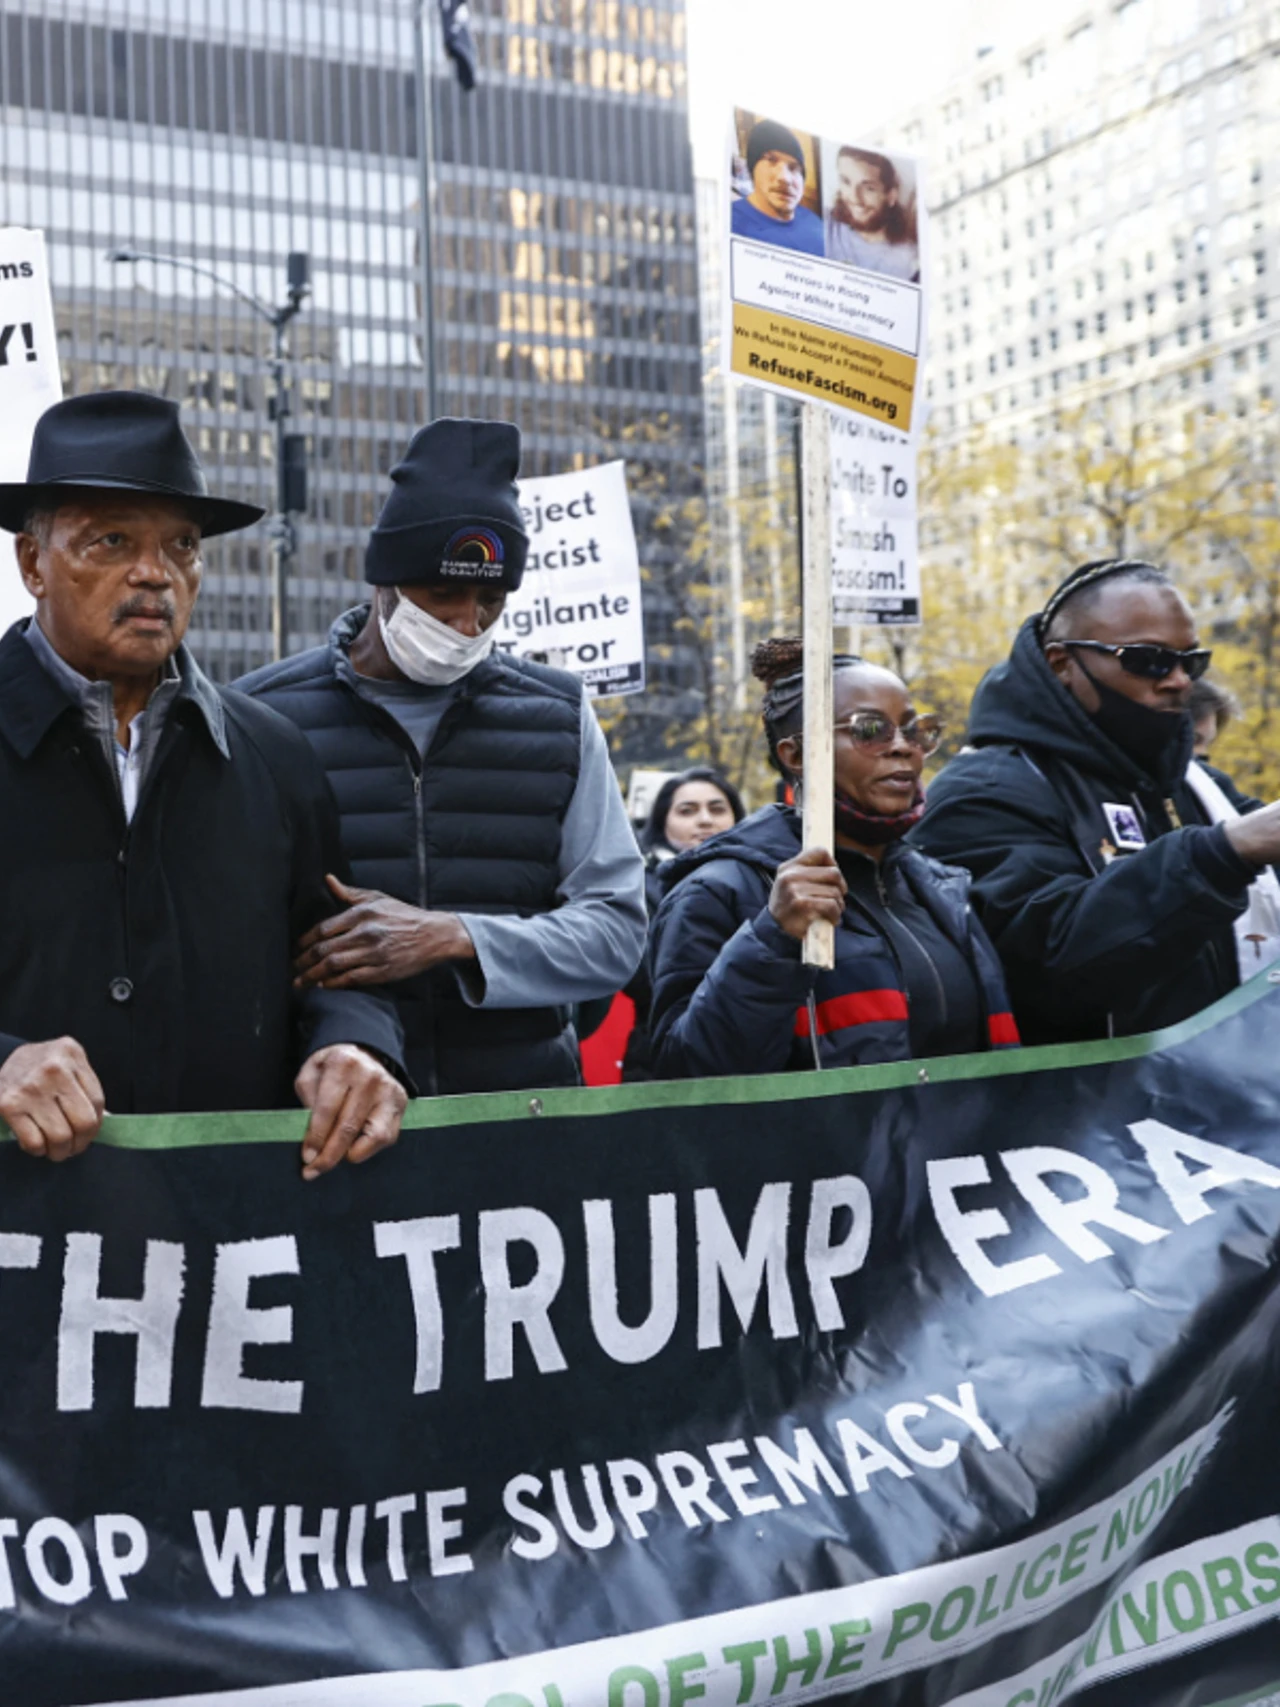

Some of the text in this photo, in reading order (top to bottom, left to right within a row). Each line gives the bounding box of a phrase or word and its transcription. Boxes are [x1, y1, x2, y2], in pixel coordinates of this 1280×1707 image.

[734, 325, 749, 338] We
[752, 331, 786, 349] Refuse
[800, 344, 834, 364] Accept
[842, 357, 876, 378] Fascist
[877, 371, 913, 392] America
[769, 322, 884, 367] In the Name of Humanity
[748, 351, 898, 420] RefuseFascism.org
[881, 464, 908, 498] To
[521, 490, 597, 534] eject
[524, 537, 602, 572] acist
[502, 593, 629, 637] igilante
[373, 1174, 870, 1394] TRUMP
[925, 1118, 1280, 1298] ERA
[192, 1487, 474, 1598] WHITE
[502, 1382, 1003, 1561] SUPREMACY
[722, 1616, 871, 1707] THE
[881, 1524, 1099, 1659] POLICE
